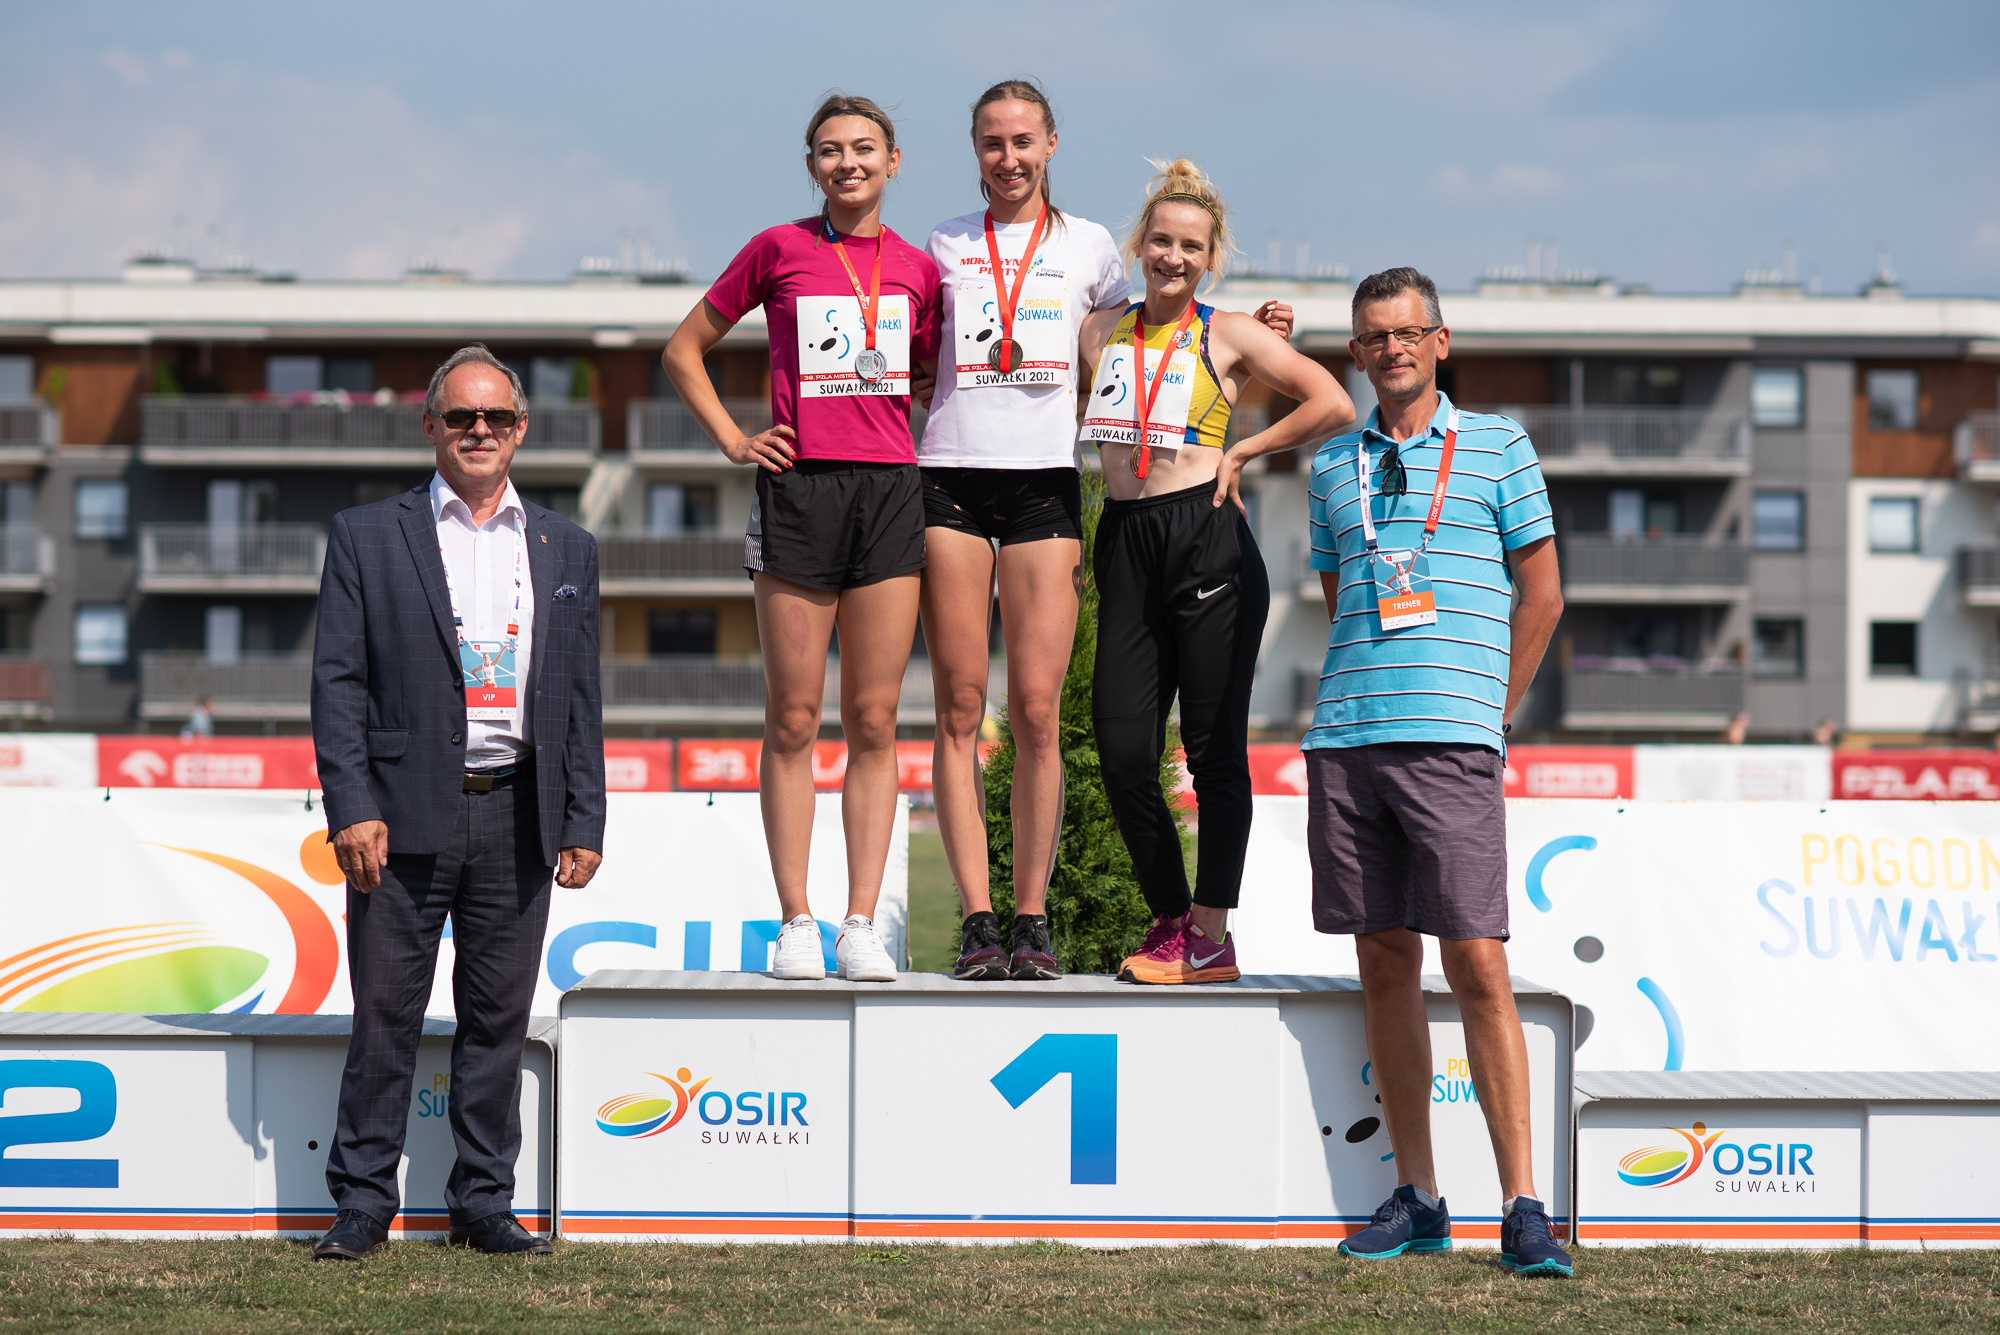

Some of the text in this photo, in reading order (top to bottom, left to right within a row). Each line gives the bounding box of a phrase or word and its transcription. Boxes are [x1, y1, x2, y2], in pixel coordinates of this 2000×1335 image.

[1024, 299, 1062, 309] POGODNE
[1017, 307, 1063, 321] SUWAŁKI
[975, 371, 1054, 385] SUWAŁKI 2021
[819, 382, 894, 395] SUWAŁKI 2021
[1090, 428, 1164, 444] SUWAŁKI 021
[1392, 599, 1422, 611] TRENER
[482, 693, 496, 702] VIP
[1757, 878, 2000, 963] SUWAŁ
[699, 1091, 809, 1126] OSIR
[989, 1033, 1118, 1185] 1
[0, 1060, 119, 1188] 2
[701, 1131, 809, 1145] SUWAŁKI
[1713, 1143, 1815, 1176] OSIR
[1715, 1180, 1815, 1193] SUWAŁKI
